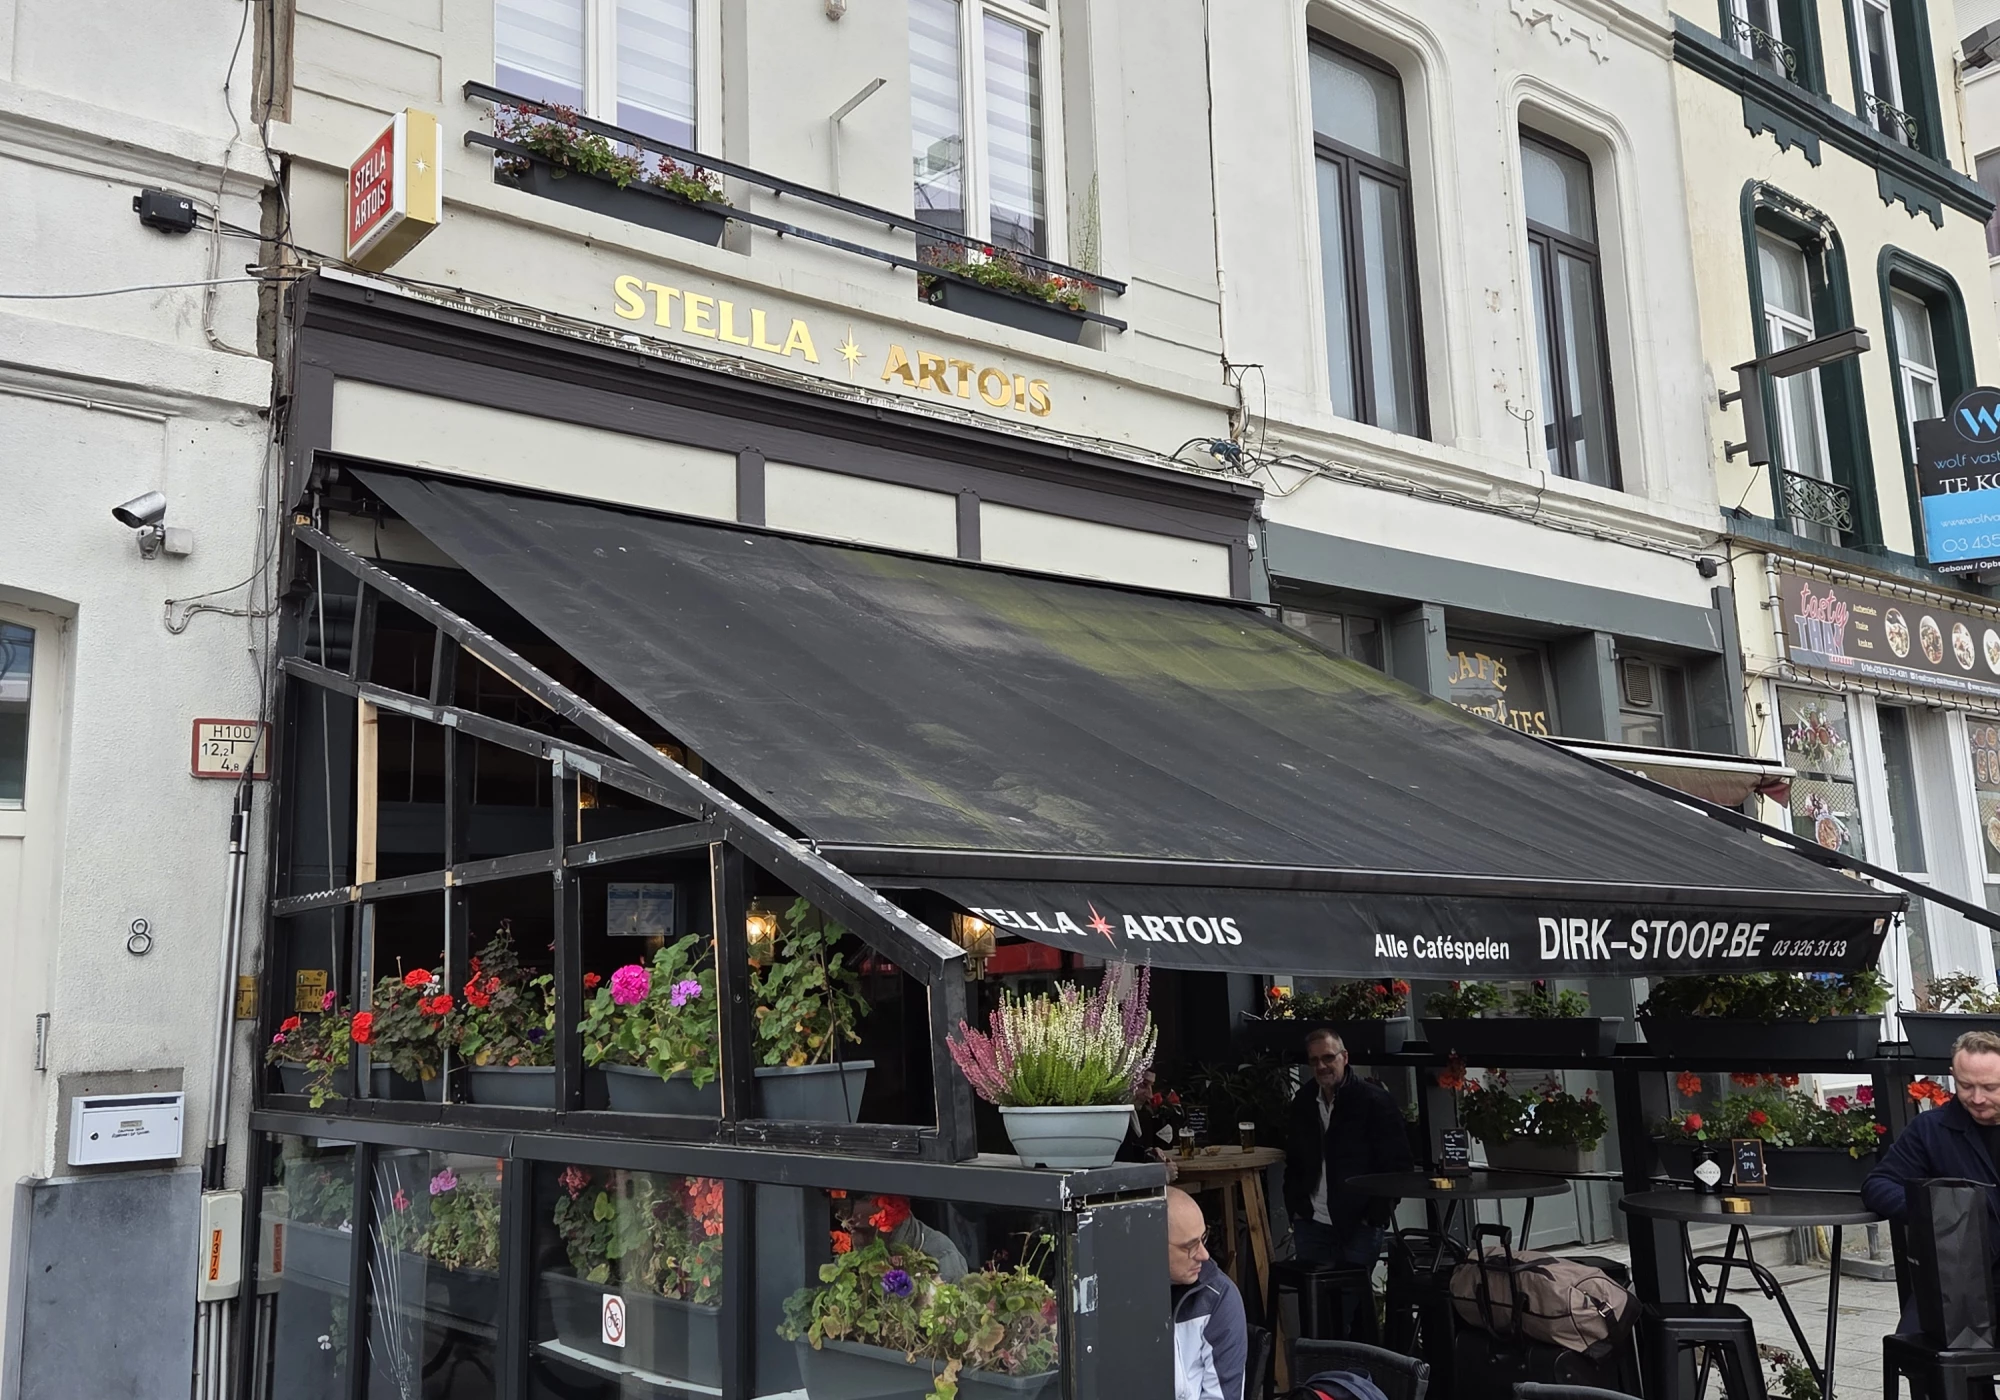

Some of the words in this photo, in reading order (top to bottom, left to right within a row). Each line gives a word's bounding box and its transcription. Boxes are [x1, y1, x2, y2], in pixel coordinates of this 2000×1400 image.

[354, 145, 387, 198] STELLA
[354, 179, 388, 231] ARTOIS
[613, 274, 819, 364] STELLA
[880, 343, 1052, 417] ARTOIS
[1934, 453, 1967, 469] wolf
[1940, 477, 1970, 495] TE
[1943, 538, 1969, 552] 03
[1938, 564, 1973, 573] Gebouw
[1800, 582, 1849, 642] tasty
[214, 725, 252, 738] H100
[202, 743, 229, 757] 12,2
[221, 758, 240, 772] 4,8
[127, 917, 153, 957] 8
[1122, 914, 1243, 946] ARTOIS
[1375, 933, 1409, 958] Alle
[1413, 934, 1510, 966] Caféspelen
[1538, 917, 1770, 961] DIRK-STOOP.BE
[1771, 940, 1791, 957] 03
[1790, 939, 1815, 957] 326
[210, 1230, 221, 1280] 7372
